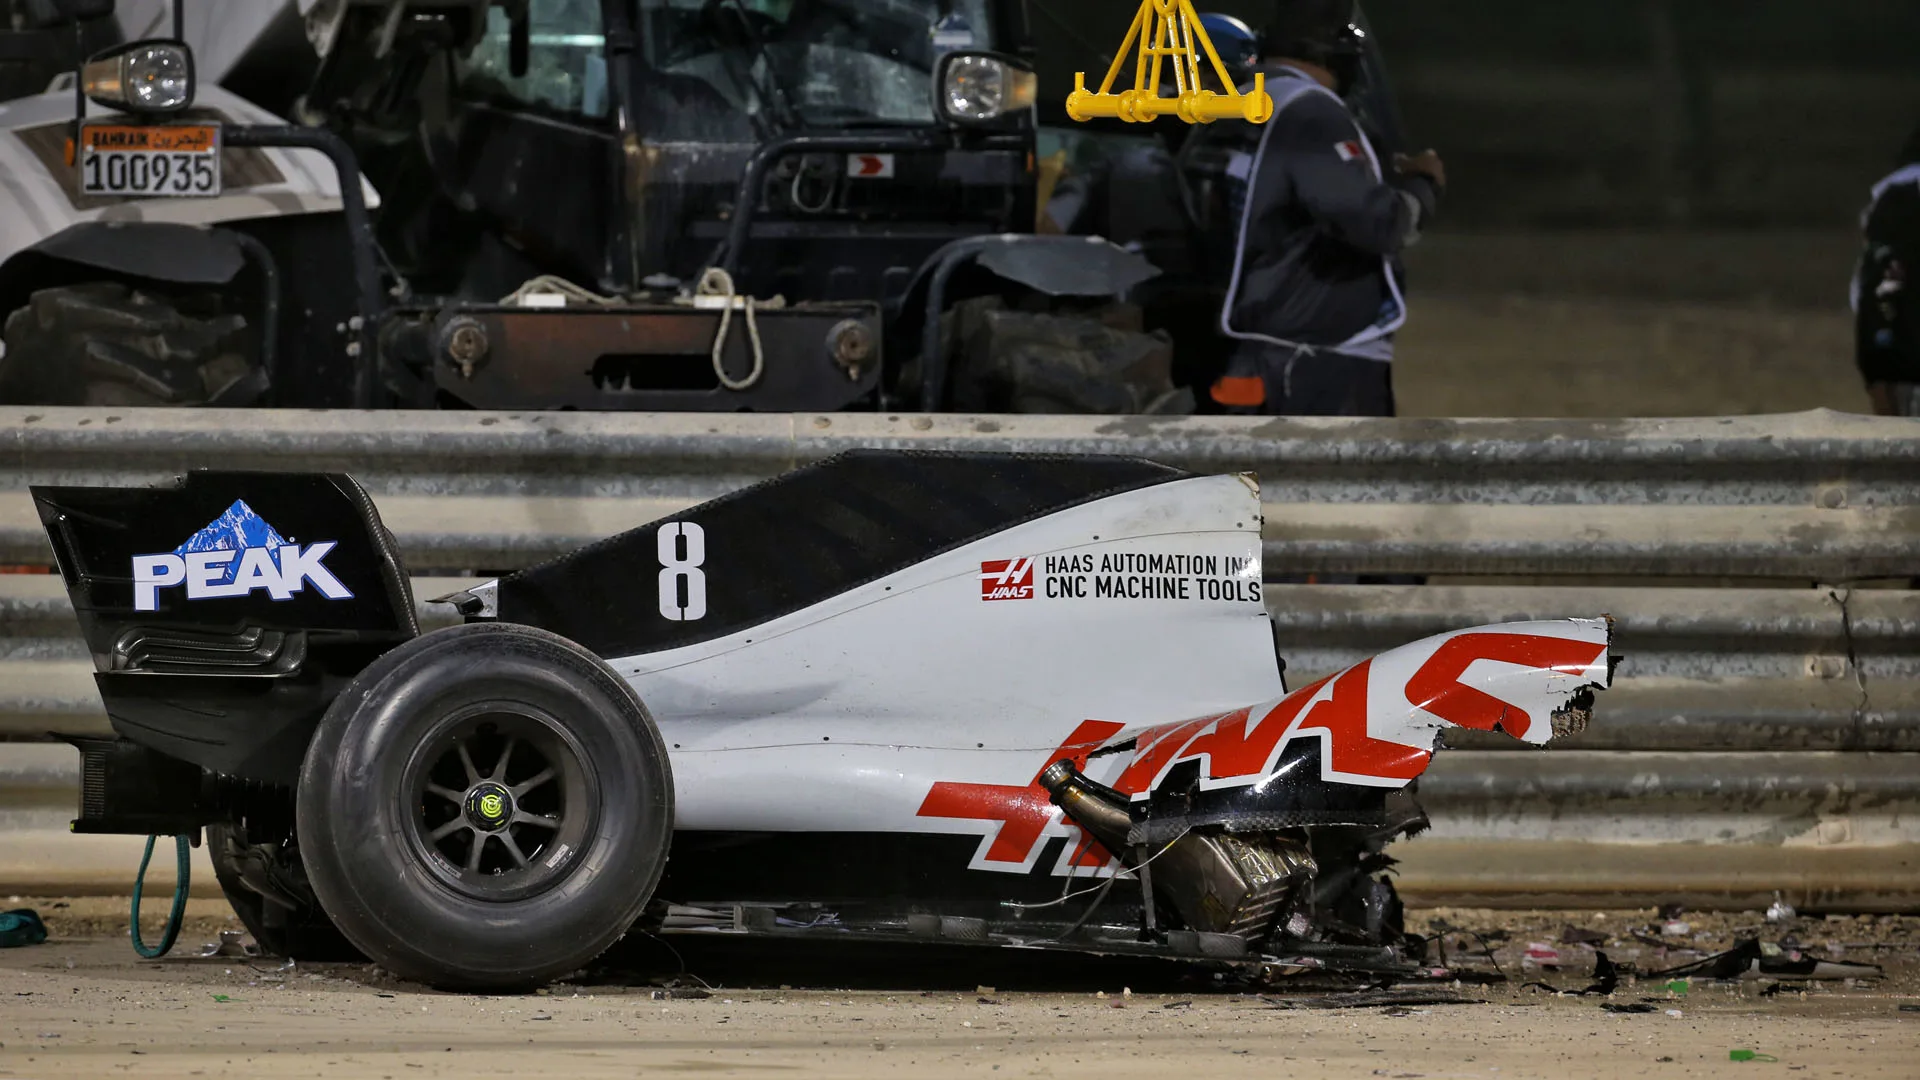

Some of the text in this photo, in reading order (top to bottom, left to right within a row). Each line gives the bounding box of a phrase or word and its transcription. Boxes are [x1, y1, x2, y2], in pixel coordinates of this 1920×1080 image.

[92, 132, 148, 146] BAHRAIN
[85, 154, 213, 191] 100935
[131, 540, 355, 612] PEAK
[657, 521, 707, 621] 8
[1045, 554, 1093, 574] HAAS
[1100, 553, 1217, 576] AUTOMATION
[982, 585, 1033, 599] HAAS
[1045, 576, 1261, 602] CNC MACHINE TOOLS
